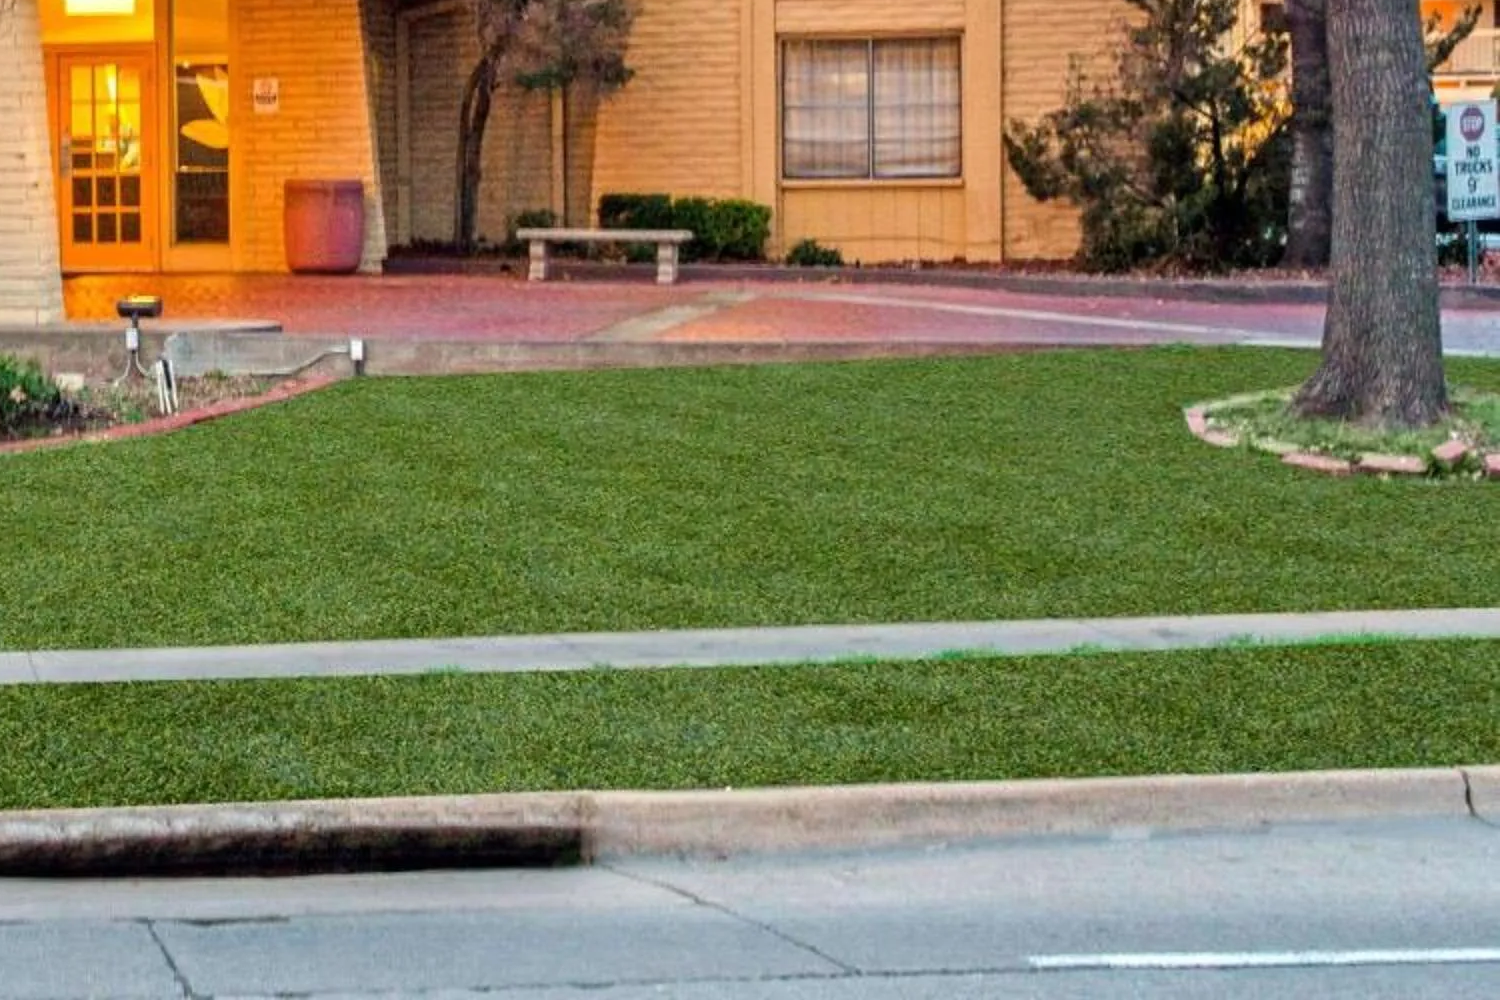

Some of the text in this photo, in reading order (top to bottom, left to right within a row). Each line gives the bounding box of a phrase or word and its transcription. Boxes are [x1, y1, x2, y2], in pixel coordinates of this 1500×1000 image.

[1466, 144, 1480, 158] NO
[1453, 160, 1492, 175] TRUCKS
[1451, 195, 1496, 210] CLEARANCE
